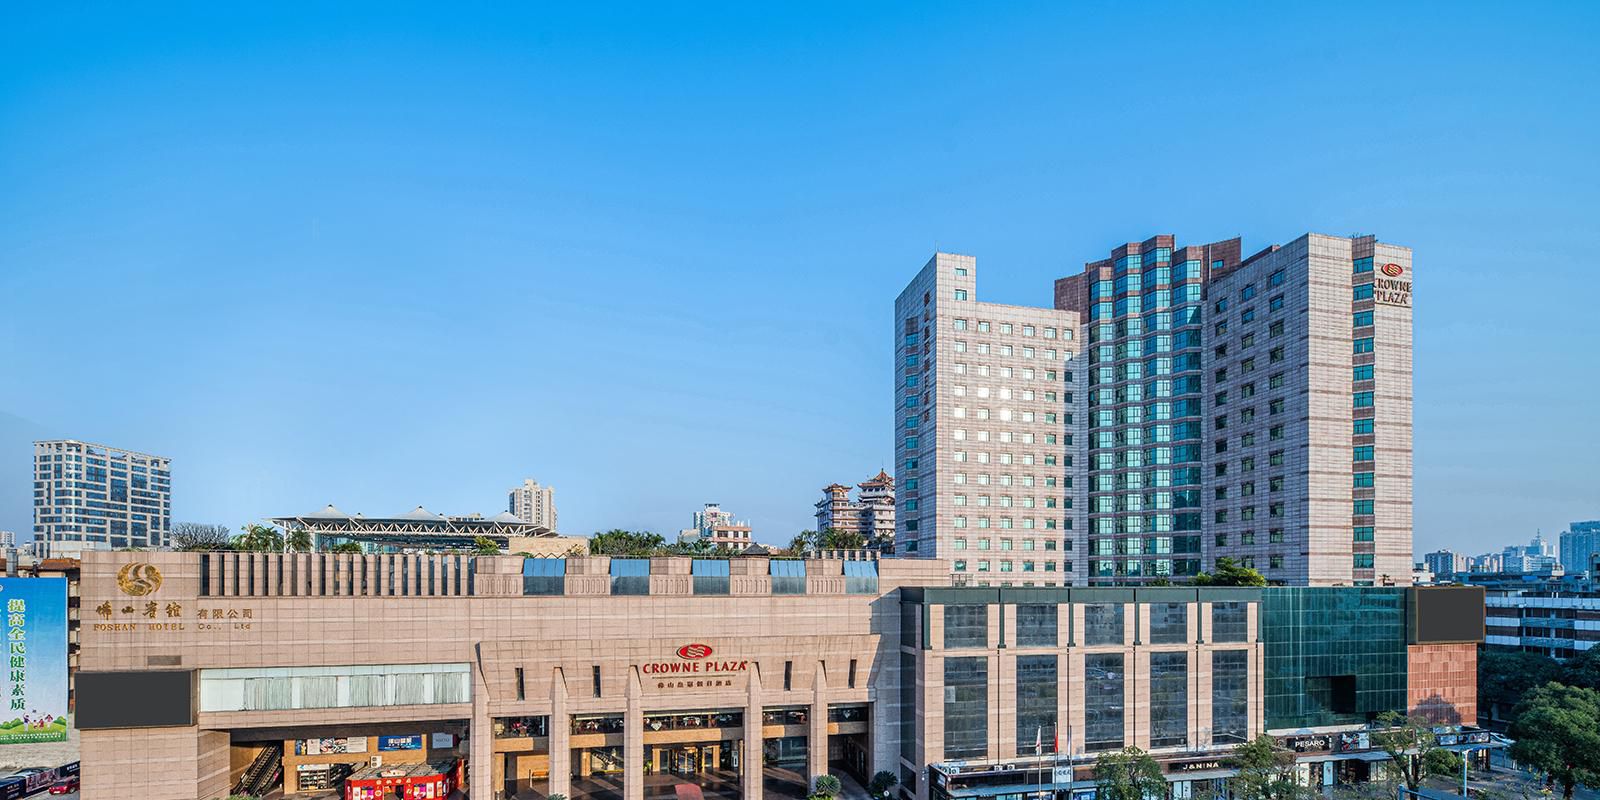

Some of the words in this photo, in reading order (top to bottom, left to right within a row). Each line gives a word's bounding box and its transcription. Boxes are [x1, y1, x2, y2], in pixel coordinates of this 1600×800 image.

[1375, 290, 1408, 304] PLAZA
[197, 608, 253, 620] 有限公司
[93, 623, 137, 632] FOSHAN
[149, 622, 185, 631] HOTEL
[8, 599, 26, 711] 提高全民健康素质
[643, 662, 699, 674] CROWNE
[705, 661, 747, 672] PLAZA
[1295, 740, 1325, 748] PESARO
